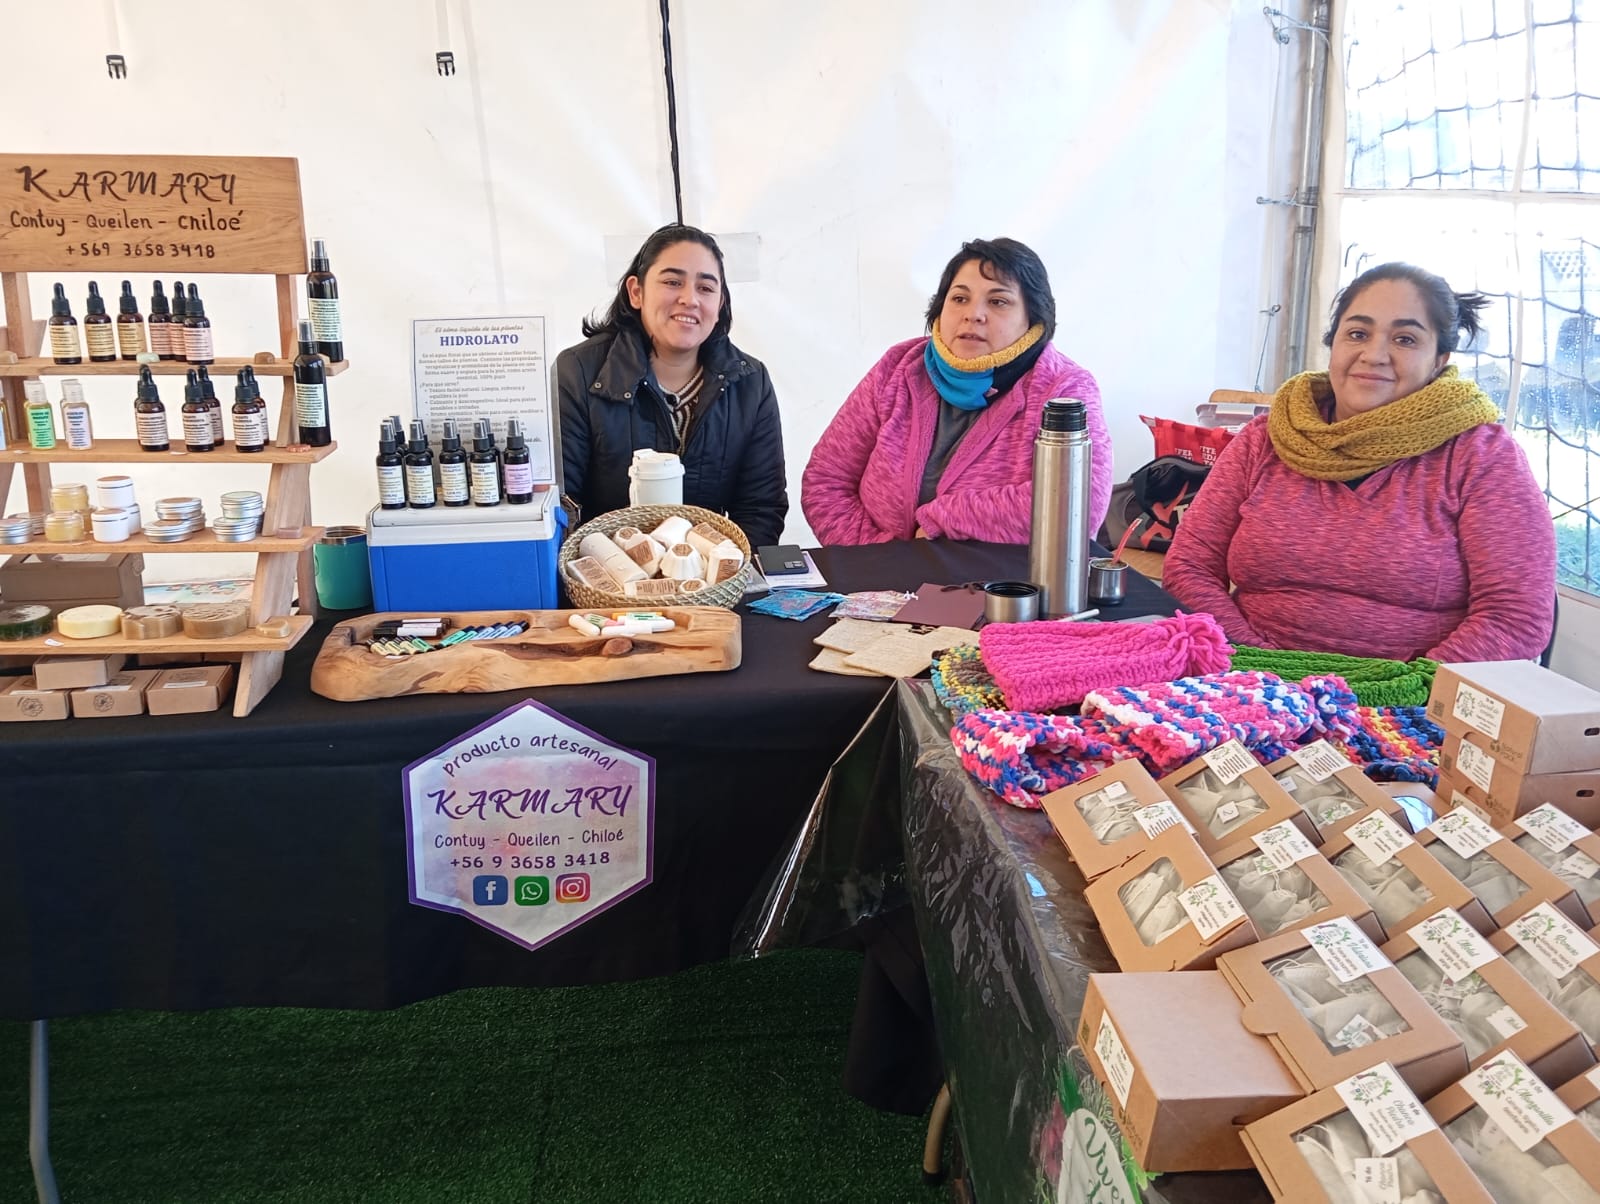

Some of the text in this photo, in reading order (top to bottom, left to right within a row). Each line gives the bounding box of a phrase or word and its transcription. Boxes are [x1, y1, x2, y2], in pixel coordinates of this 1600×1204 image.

[15, 166, 236, 205] KARMARY
[10, 209, 65, 236] Contuy
[87, 208, 152, 229] Queilen
[440, 334, 519, 346] HIDROLATO
[443, 734, 618, 777] producto artesanal
[427, 785, 632, 820] KARMARY
[435, 834, 485, 849] Contuy
[508, 832, 560, 847] Queilen
[582, 829, 625, 844] Chiloé
[450, 852, 610, 869] +56 9 3658 3418
